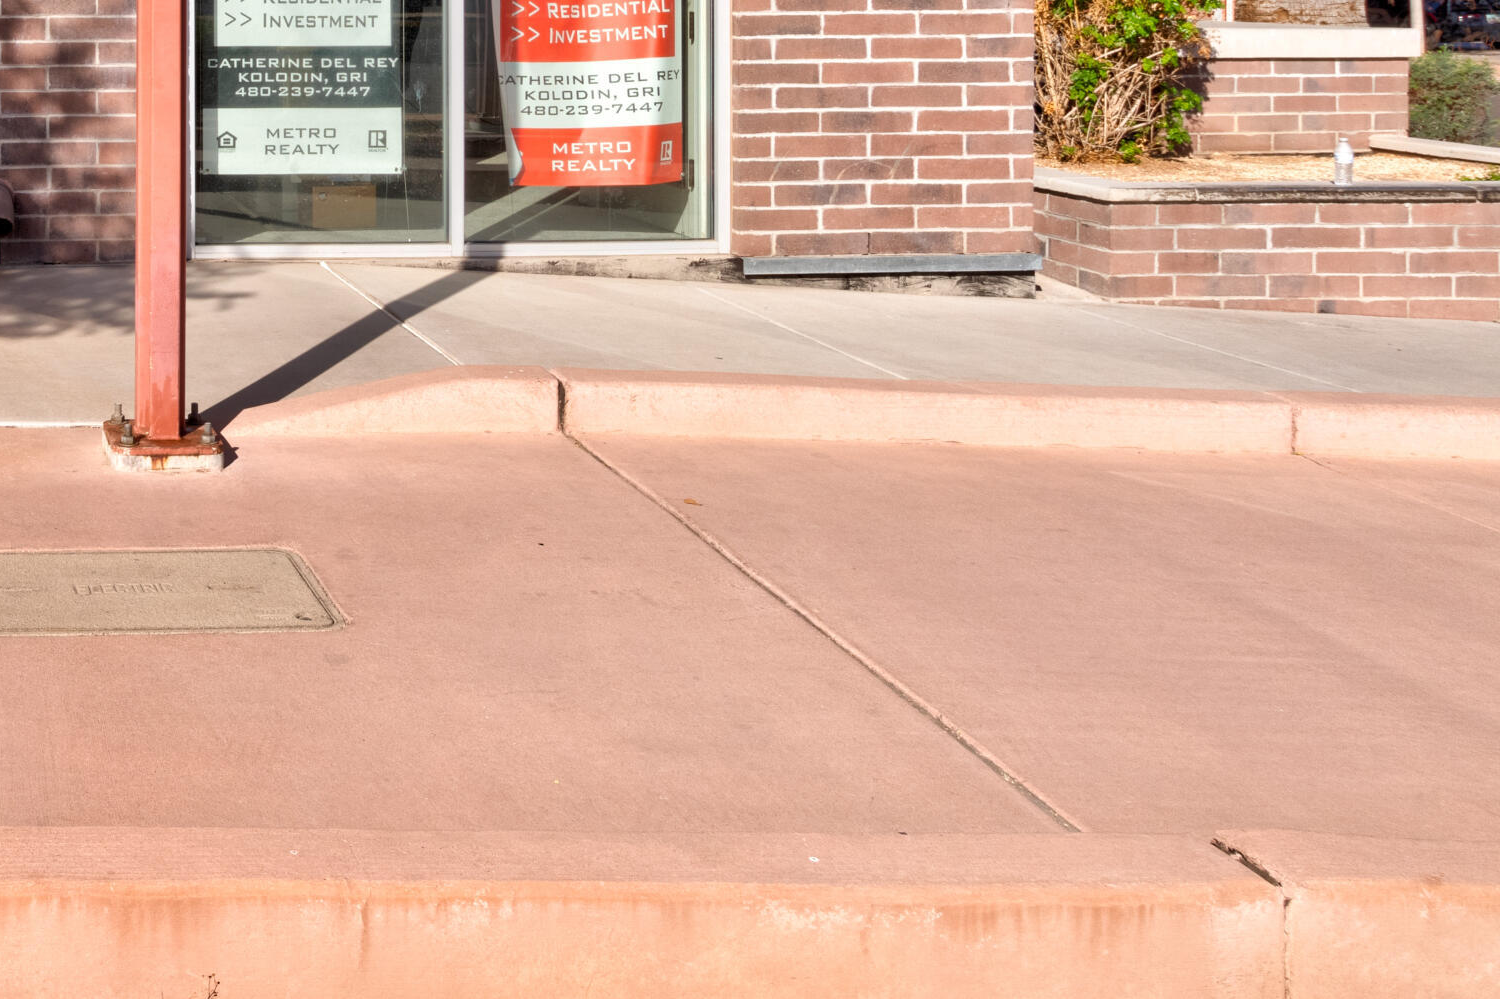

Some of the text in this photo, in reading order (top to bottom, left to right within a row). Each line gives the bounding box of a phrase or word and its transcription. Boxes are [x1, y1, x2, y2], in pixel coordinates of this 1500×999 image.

[548, 0, 671, 18] RESIDENTIAL
[263, 13, 378, 28] INVESTMENT
[550, 24, 668, 43] INVESTMENT
[208, 58, 399, 68] CATHERINE DEL REY
[238, 73, 367, 84] KOLODIN, GRI
[608, 72, 648, 83] DEL
[657, 70, 680, 81] REY
[235, 87, 370, 97] 480-239-7447
[525, 86, 661, 101] KOLODIN, GRI
[520, 102, 664, 115] 480-239-7447
[266, 128, 337, 139] METRO
[265, 144, 339, 155] REALTY
[553, 141, 632, 154] METRO
[552, 158, 636, 172] REALTY
